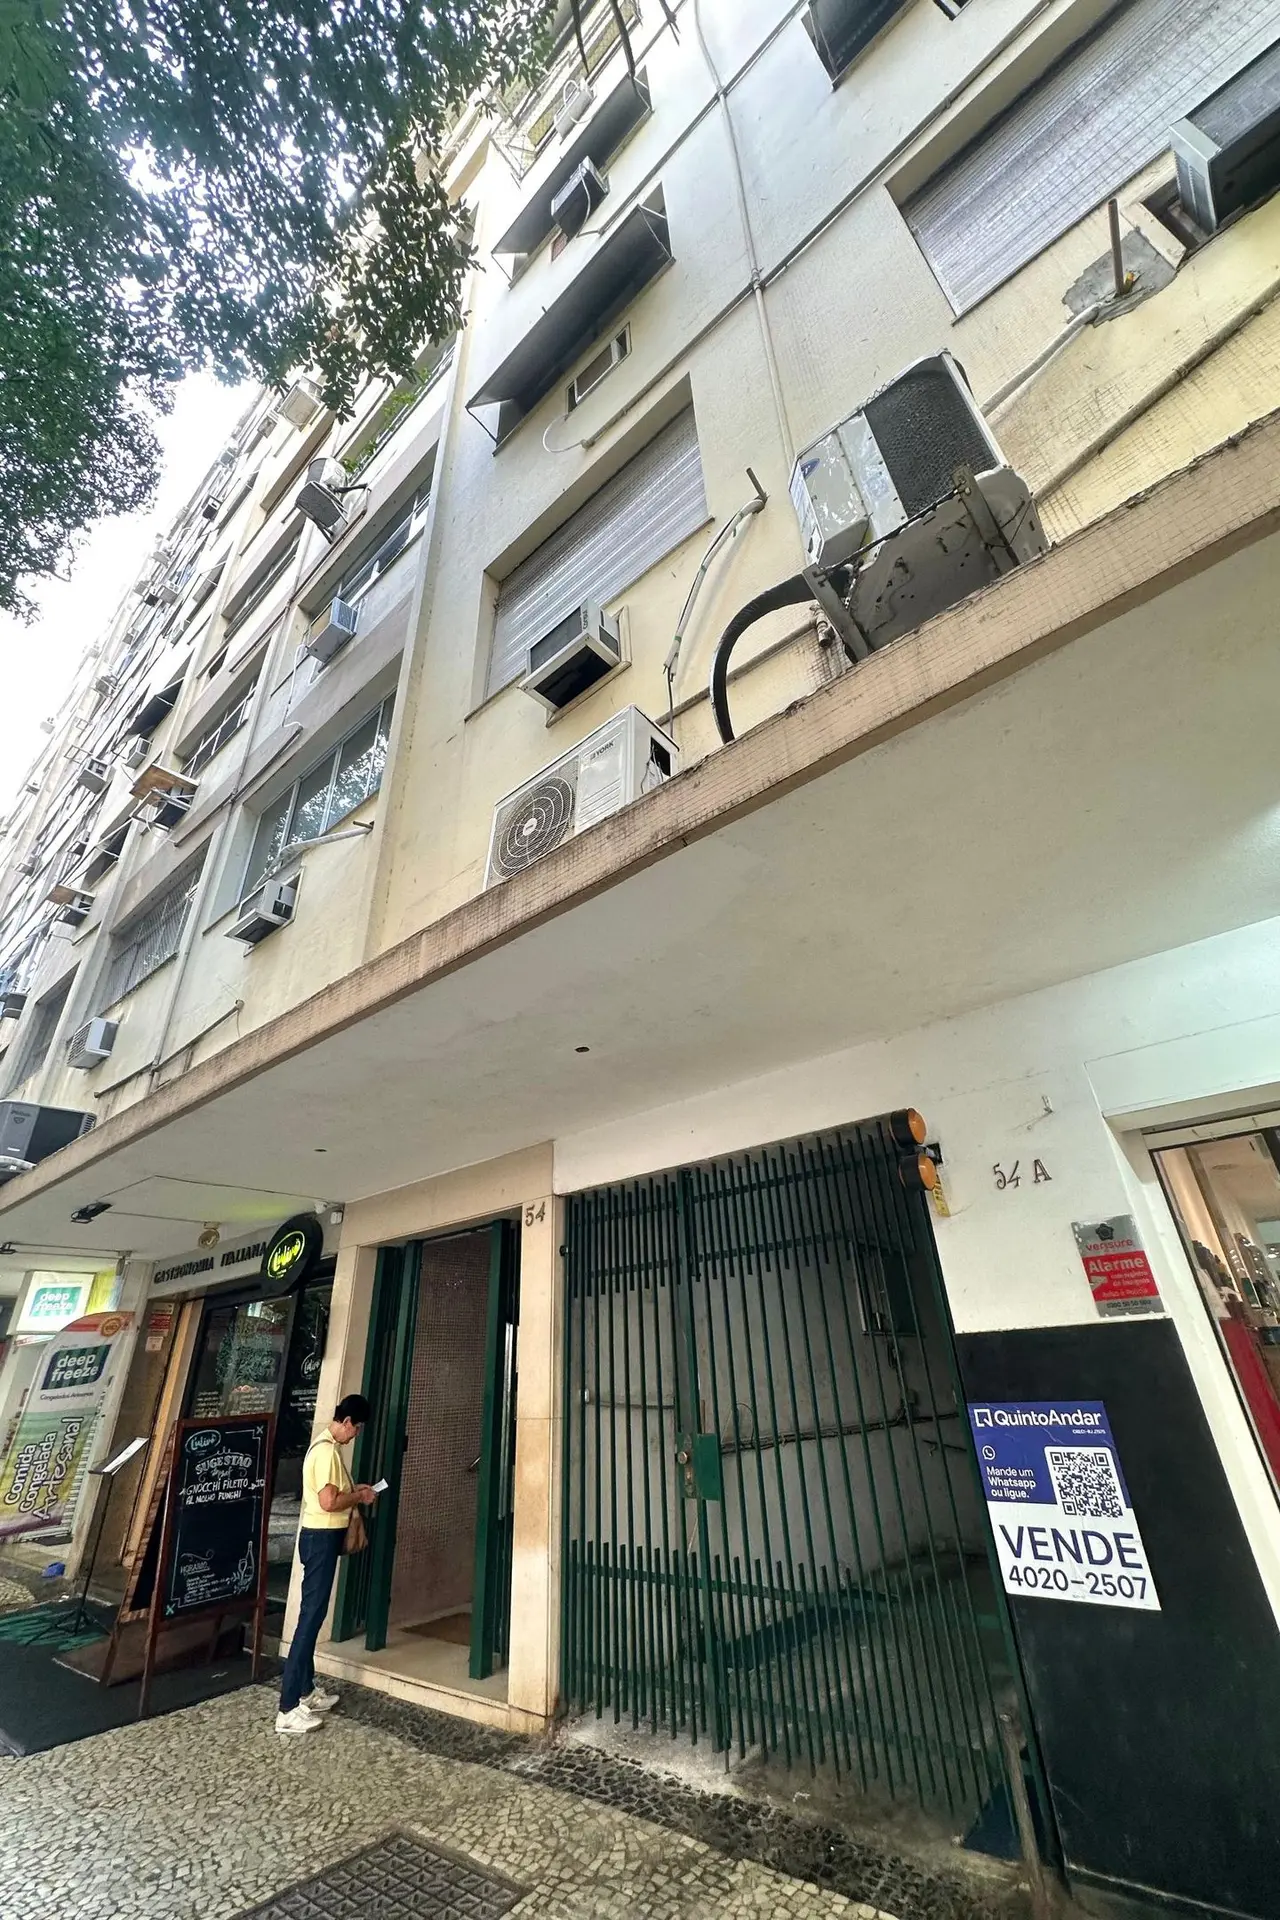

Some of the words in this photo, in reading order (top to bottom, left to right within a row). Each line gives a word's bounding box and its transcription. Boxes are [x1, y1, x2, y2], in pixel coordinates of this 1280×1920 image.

[596, 740, 614, 756] YORK
[1033, 1158, 1052, 1183] A
[525, 1201, 546, 1227] 54
[154, 1257, 214, 1285] GASTRONOMIA
[220, 1241, 267, 1268] ITALIANA
[1088, 1258, 1145, 1273] Alarme
[40, 1291, 69, 1302] deep
[36, 1300, 73, 1311] freeze
[57, 1354, 96, 1369] deep
[51, 1365, 99, 1381] freeze
[994, 1409, 1101, 1427] QuintoAndar
[5, 1444, 37, 1504] Comida
[20, 1431, 58, 1513] Congelada
[33, 1417, 84, 1520] Artesanal
[986, 1466, 1018, 1477] Mande
[1019, 1469, 1034, 1477] um
[187, 1479, 221, 1496] GNOCCHI
[222, 1478, 249, 1490] FILETTO
[988, 1476, 1037, 1489] Whatsapp
[218, 1490, 242, 1500] FUNGHI
[991, 1488, 1003, 1497] ou
[1004, 1488, 1030, 1500] ligue.
[999, 1524, 1143, 1569] VENDE
[1009, 1565, 1147, 1600] 4020-2507
